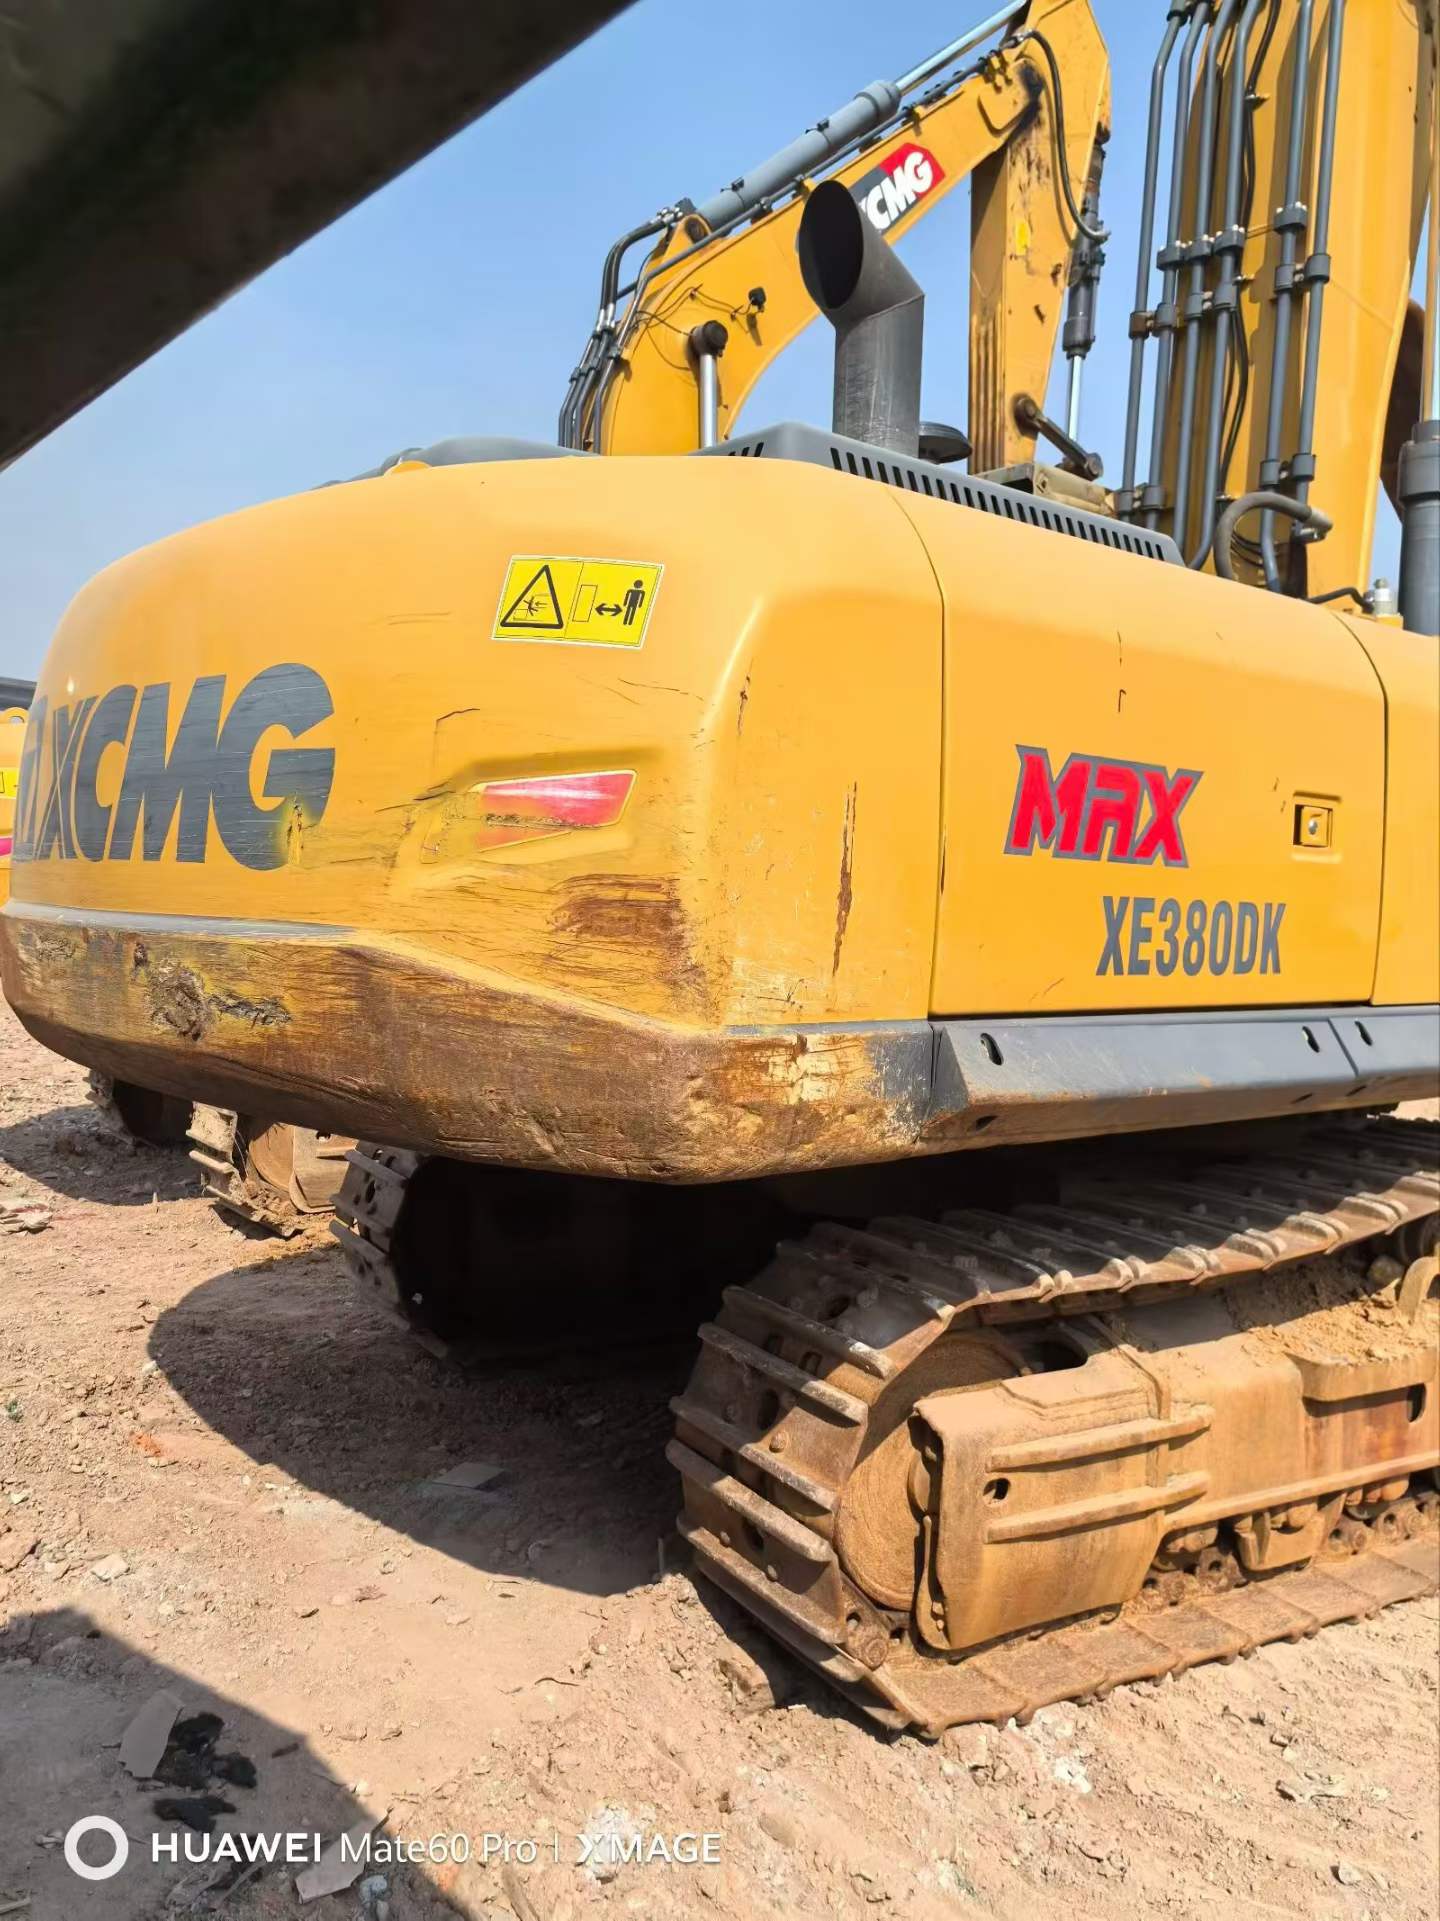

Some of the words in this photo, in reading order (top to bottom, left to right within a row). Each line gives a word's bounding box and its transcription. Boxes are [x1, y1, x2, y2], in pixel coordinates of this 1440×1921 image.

[859, 151, 933, 230] CMG
[34, 663, 336, 870] XCMG
[1003, 744, 1204, 868] MAX
[1096, 896, 1286, 976] XE380DK
